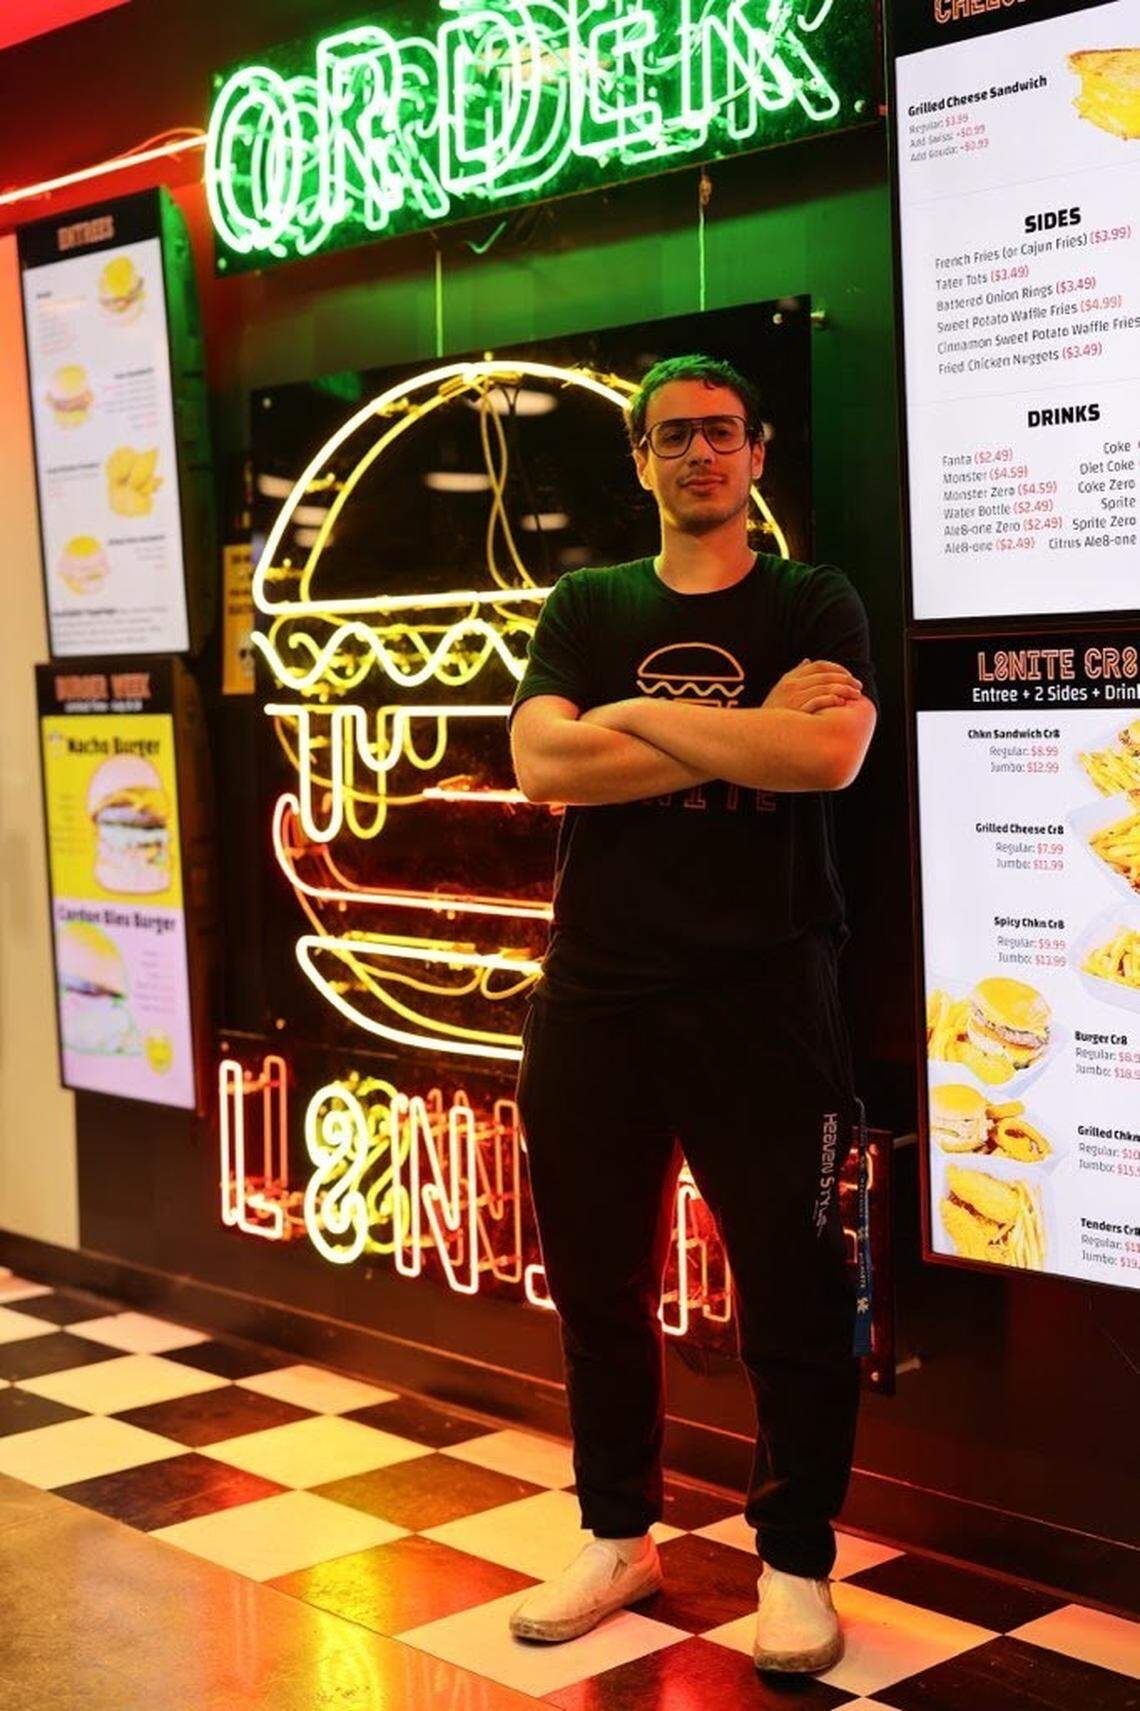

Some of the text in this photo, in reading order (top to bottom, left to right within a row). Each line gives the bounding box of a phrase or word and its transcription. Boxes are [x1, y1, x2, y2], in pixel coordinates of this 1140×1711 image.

[908, 75, 1047, 117] Grilled Cheese Sandwich
[205, 0, 842, 257] ORDER
[1024, 206, 1081, 234] SIDES
[935, 225, 1131, 269] French Fries (or Cajun Fries) ($3.99)
[936, 265, 1029, 291] Tater Tots ($3.49)
[937, 276, 1096, 312] Battered Onion Rings ($3.49)
[937, 295, 1123, 334] Sweet Potato Waffle Fries ($4.99)
[938, 314, 1140, 355] Cinnamon Sweet Potato Waffle Fries
[939, 342, 1102, 376] Fried Chicken Nuggets ($3.49)
[1028, 404, 1100, 428] DRINKS
[1103, 441, 1131, 455] Coke
[943, 448, 1013, 468] Fanta ($2.49)
[943, 465, 1028, 484] Monster ($4.59)
[1080, 460, 1135, 475] Diet Coke
[944, 488, 987, 502] Monster
[991, 485, 1015, 498] Zero
[1078, 479, 1135, 494] Coke Zero
[944, 499, 1054, 520] Water Bottle ($2.49)
[1101, 496, 1136, 512] Sprite
[944, 517, 1063, 537] Ale8-one Zero ($2.49)
[1072, 516, 1136, 532] Sprite Zero
[944, 537, 1035, 555] Ale8-one ($2.49)
[1049, 534, 1136, 550] Citrus Ale8-one
[978, 646, 1138, 682] L8NITE CR8
[972, 686, 1018, 703] Entree
[1022, 689, 1030, 699] +
[1035, 686, 1044, 702] 2
[1047, 684, 1088, 701] Sides
[1092, 688, 1100, 697] +
[968, 728, 1060, 740] Chkn Sandwich Cr8
[67, 736, 160, 758] Nacho Burger
[990, 762, 1025, 773] Jumbo:
[976, 823, 1064, 835] Grilled Cheese Cr8
[995, 842, 1035, 856] Regular:
[996, 858, 1031, 869] Jumbo:
[134, 912, 175, 934] Burger
[994, 916, 1065, 930] Spicy Chkn Cr8
[998, 952, 1032, 964] Jumbo:
[1075, 1031, 1128, 1046] Burger Cr8
[1077, 1125, 1140, 1143] Grilled Chkn
[1080, 1217, 1123, 1234] Tenders
